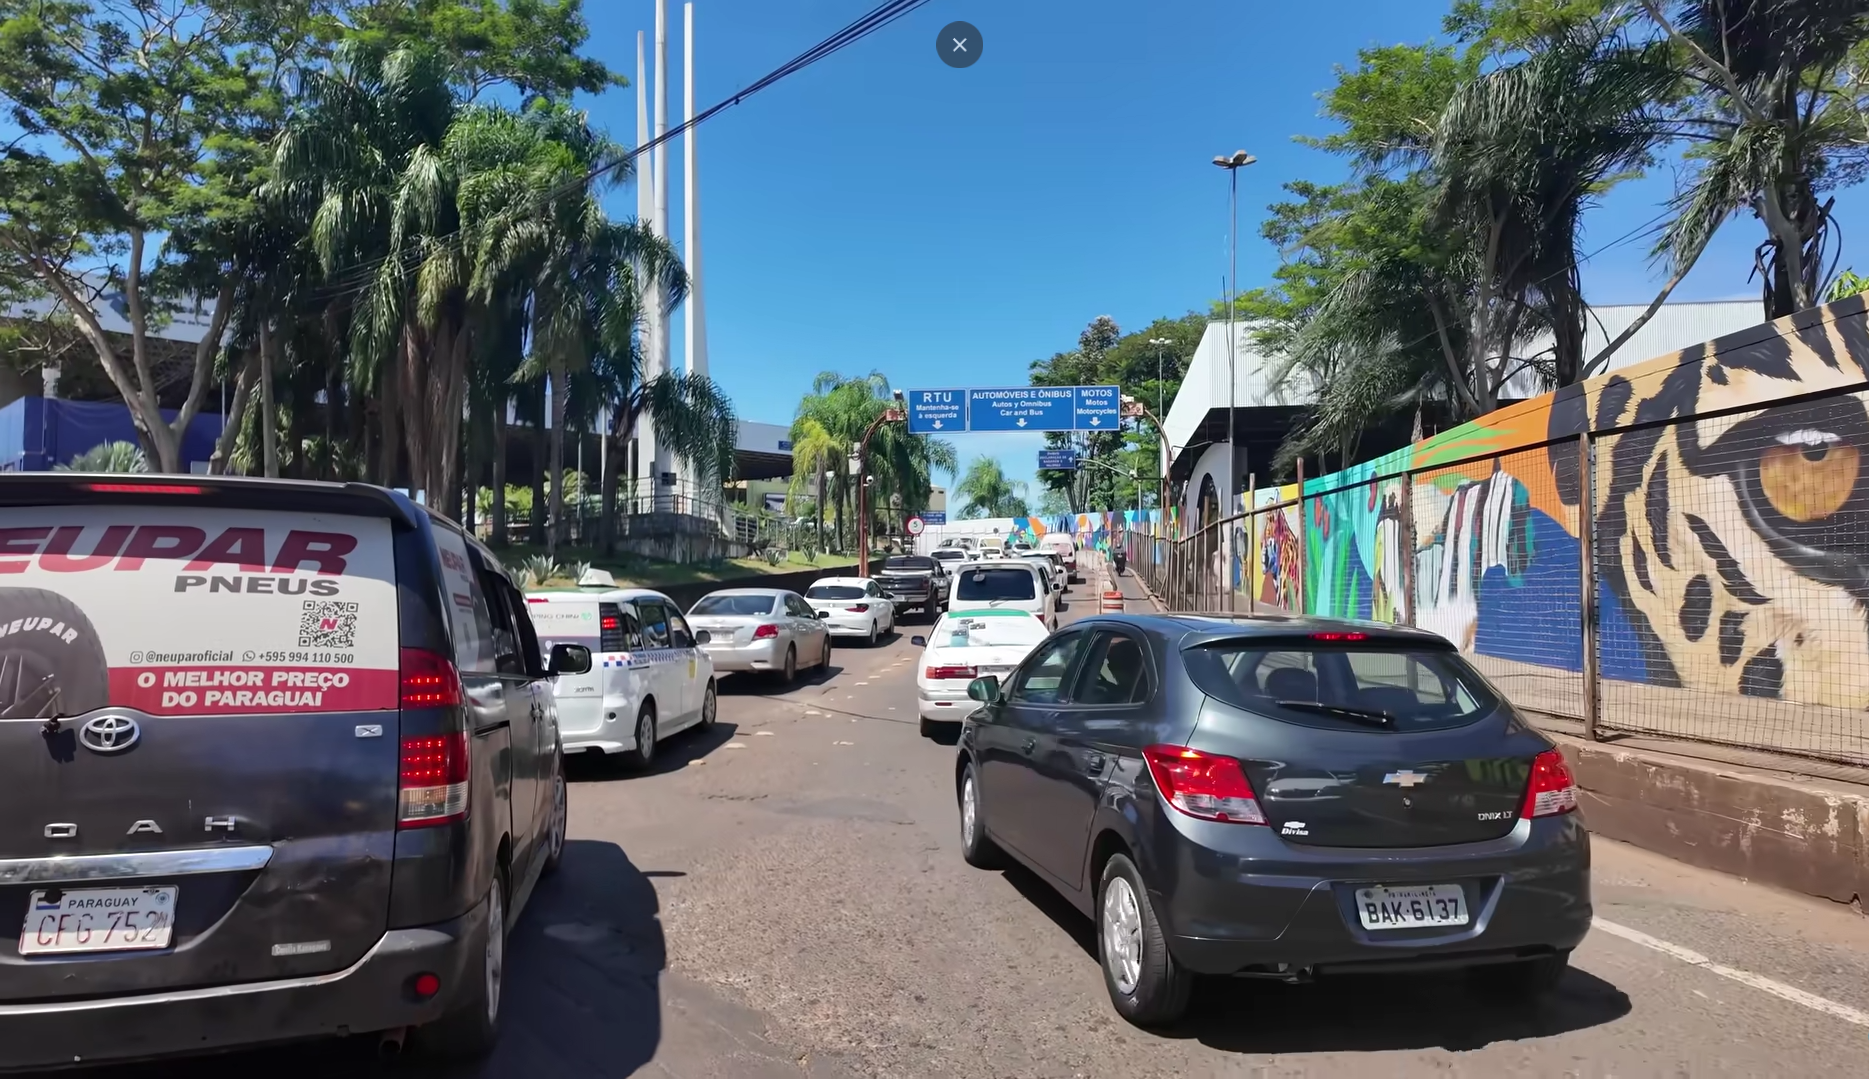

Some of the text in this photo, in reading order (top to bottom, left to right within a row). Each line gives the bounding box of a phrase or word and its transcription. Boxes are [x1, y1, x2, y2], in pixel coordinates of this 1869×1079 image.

[923, 392, 952, 403] RTU
[972, 390, 1029, 399] AUTOMÓVEIS
[1038, 389, 1072, 398] ÔNIBUS
[1081, 389, 1113, 397] MOTOS
[925, 412, 957, 420] esquerda
[1077, 407, 1117, 416] Motorcycles
[174, 575, 340, 596] PNEUS
[319, 618, 338, 630] N
[145, 650, 233, 664] @neuparoficial
[258, 652, 354, 663] +595 994 110 500
[137, 671, 350, 691] O MELHOR PREÇO
[161, 691, 323, 707] DO PARAGUAI
[1503, 811, 1513, 819] LT
[1281, 827, 1309, 836] Divisa
[68, 897, 139, 909] PARAGUAY
